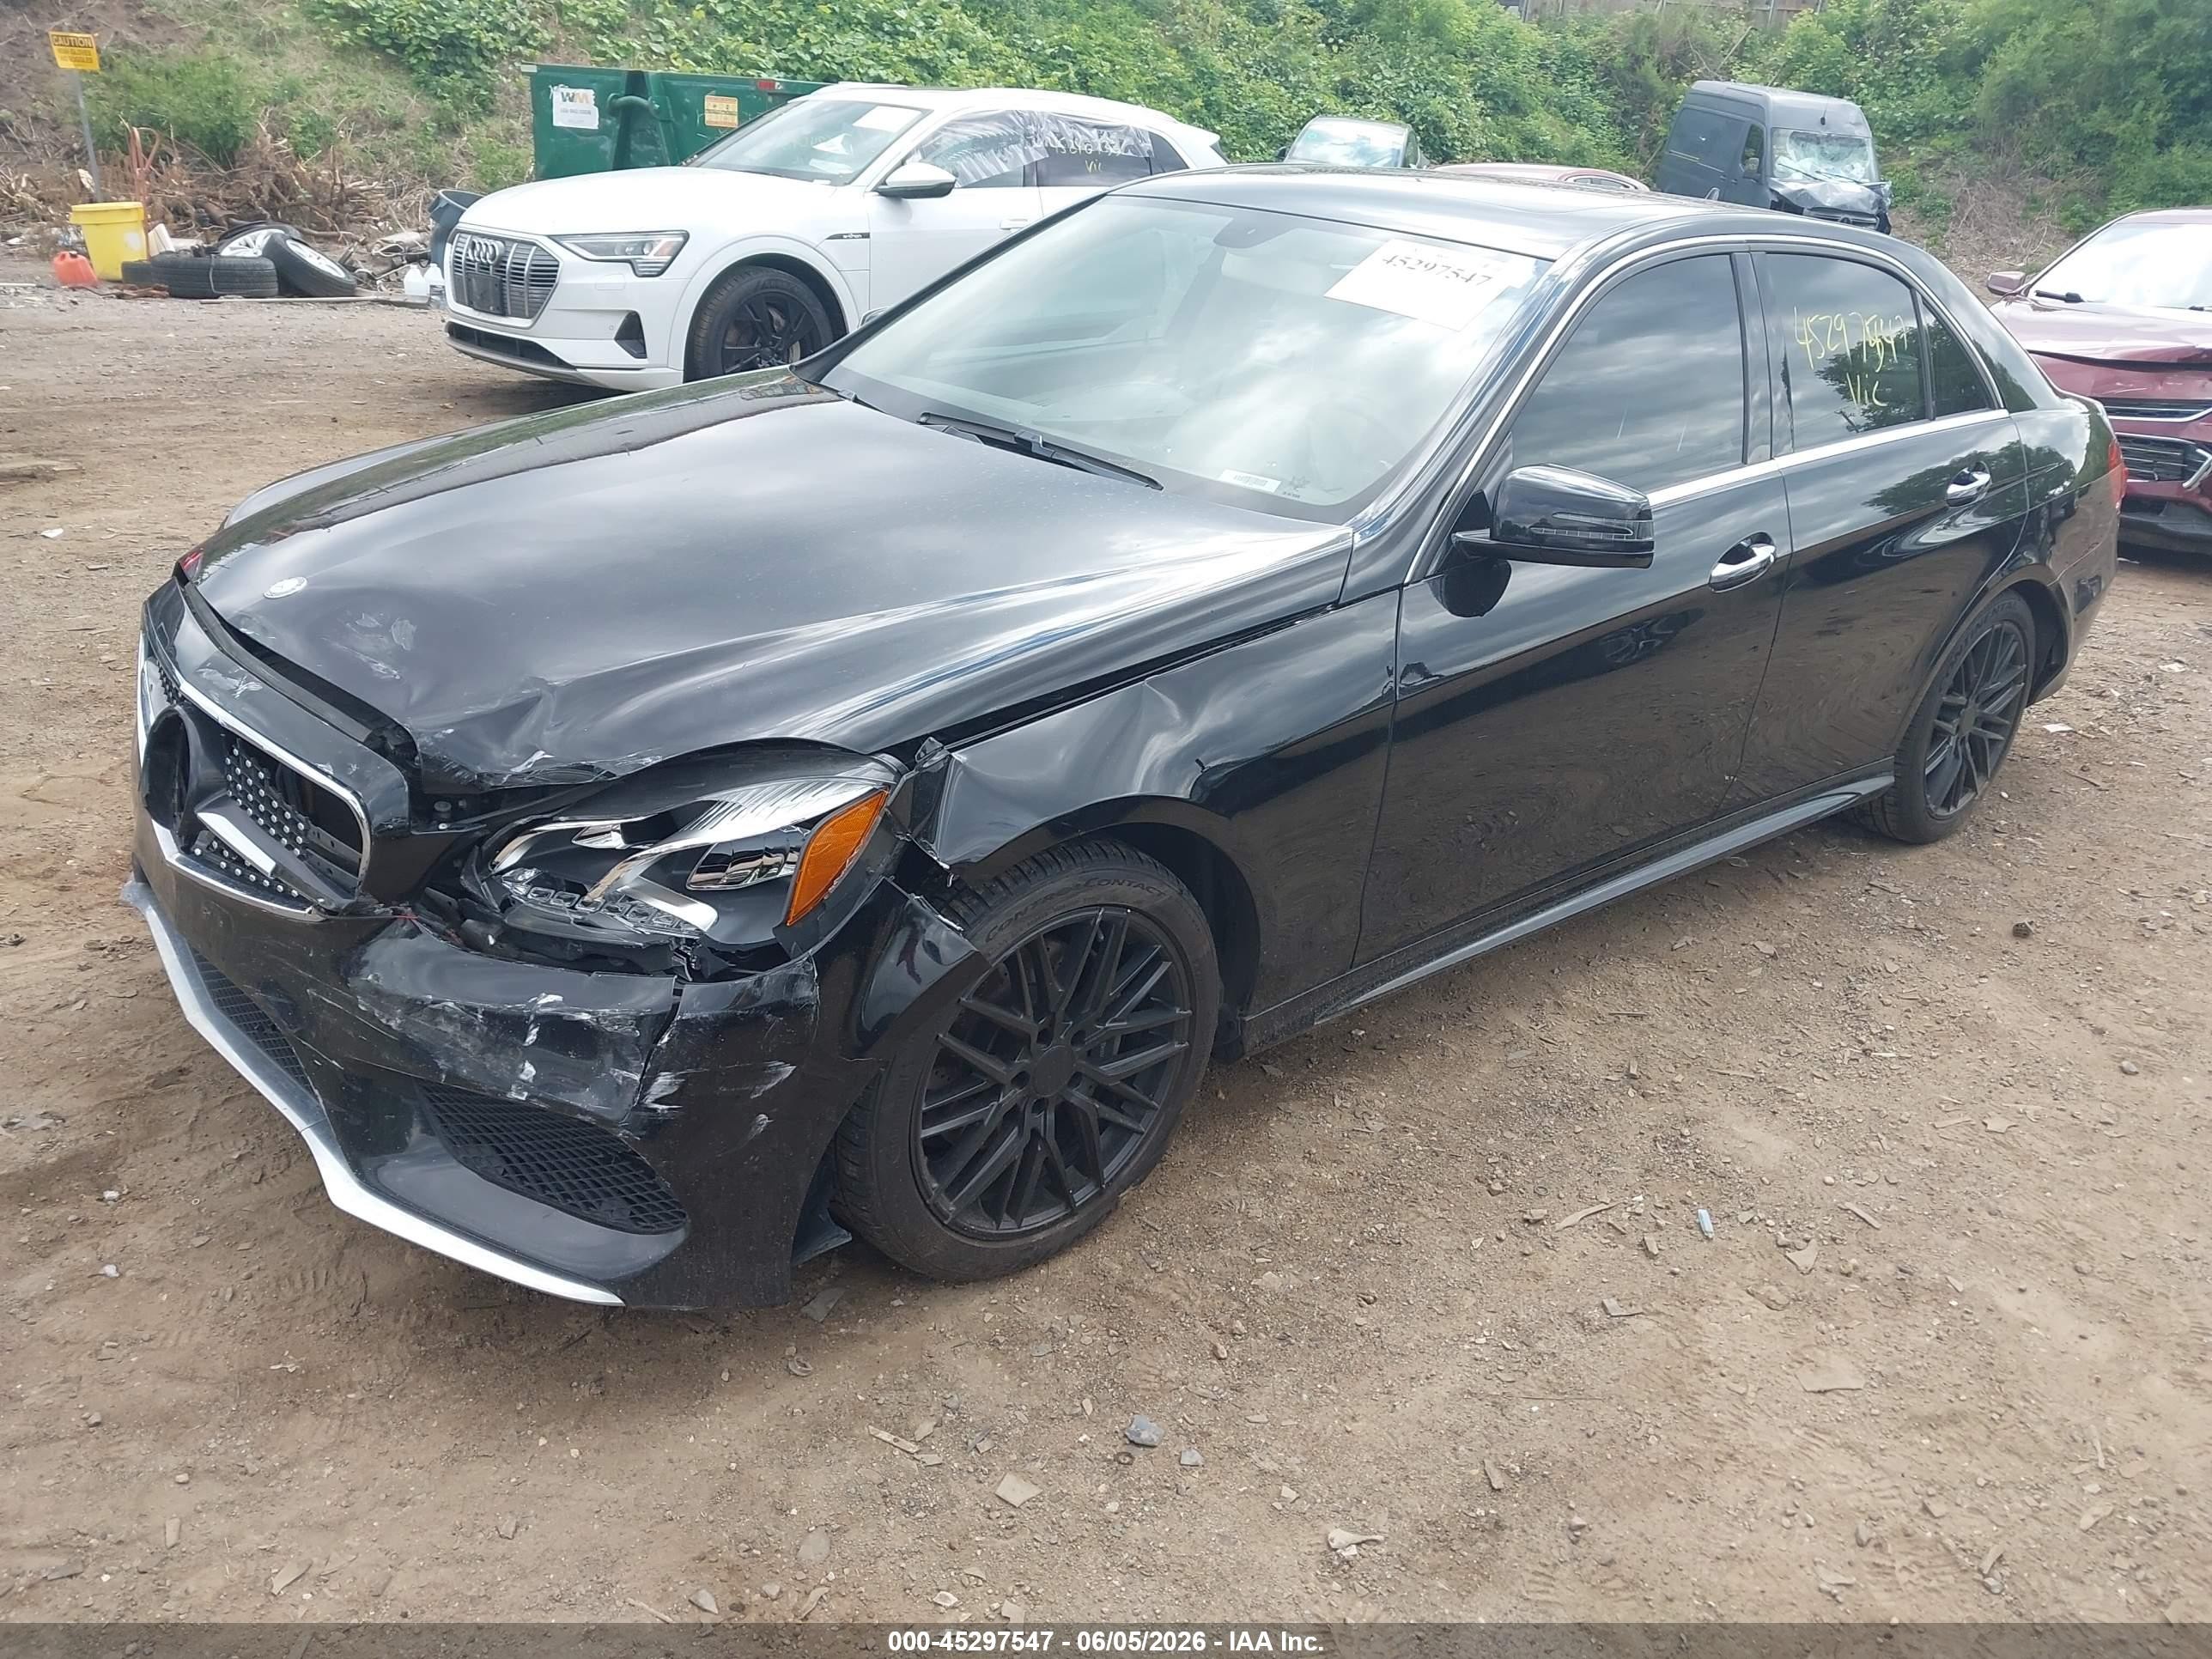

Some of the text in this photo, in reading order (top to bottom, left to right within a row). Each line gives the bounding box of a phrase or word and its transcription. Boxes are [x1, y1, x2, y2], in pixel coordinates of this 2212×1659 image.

[52, 35, 93, 47] CAUTION
[561, 91, 591, 104] WM
[1382, 254, 1493, 287] 45297547
